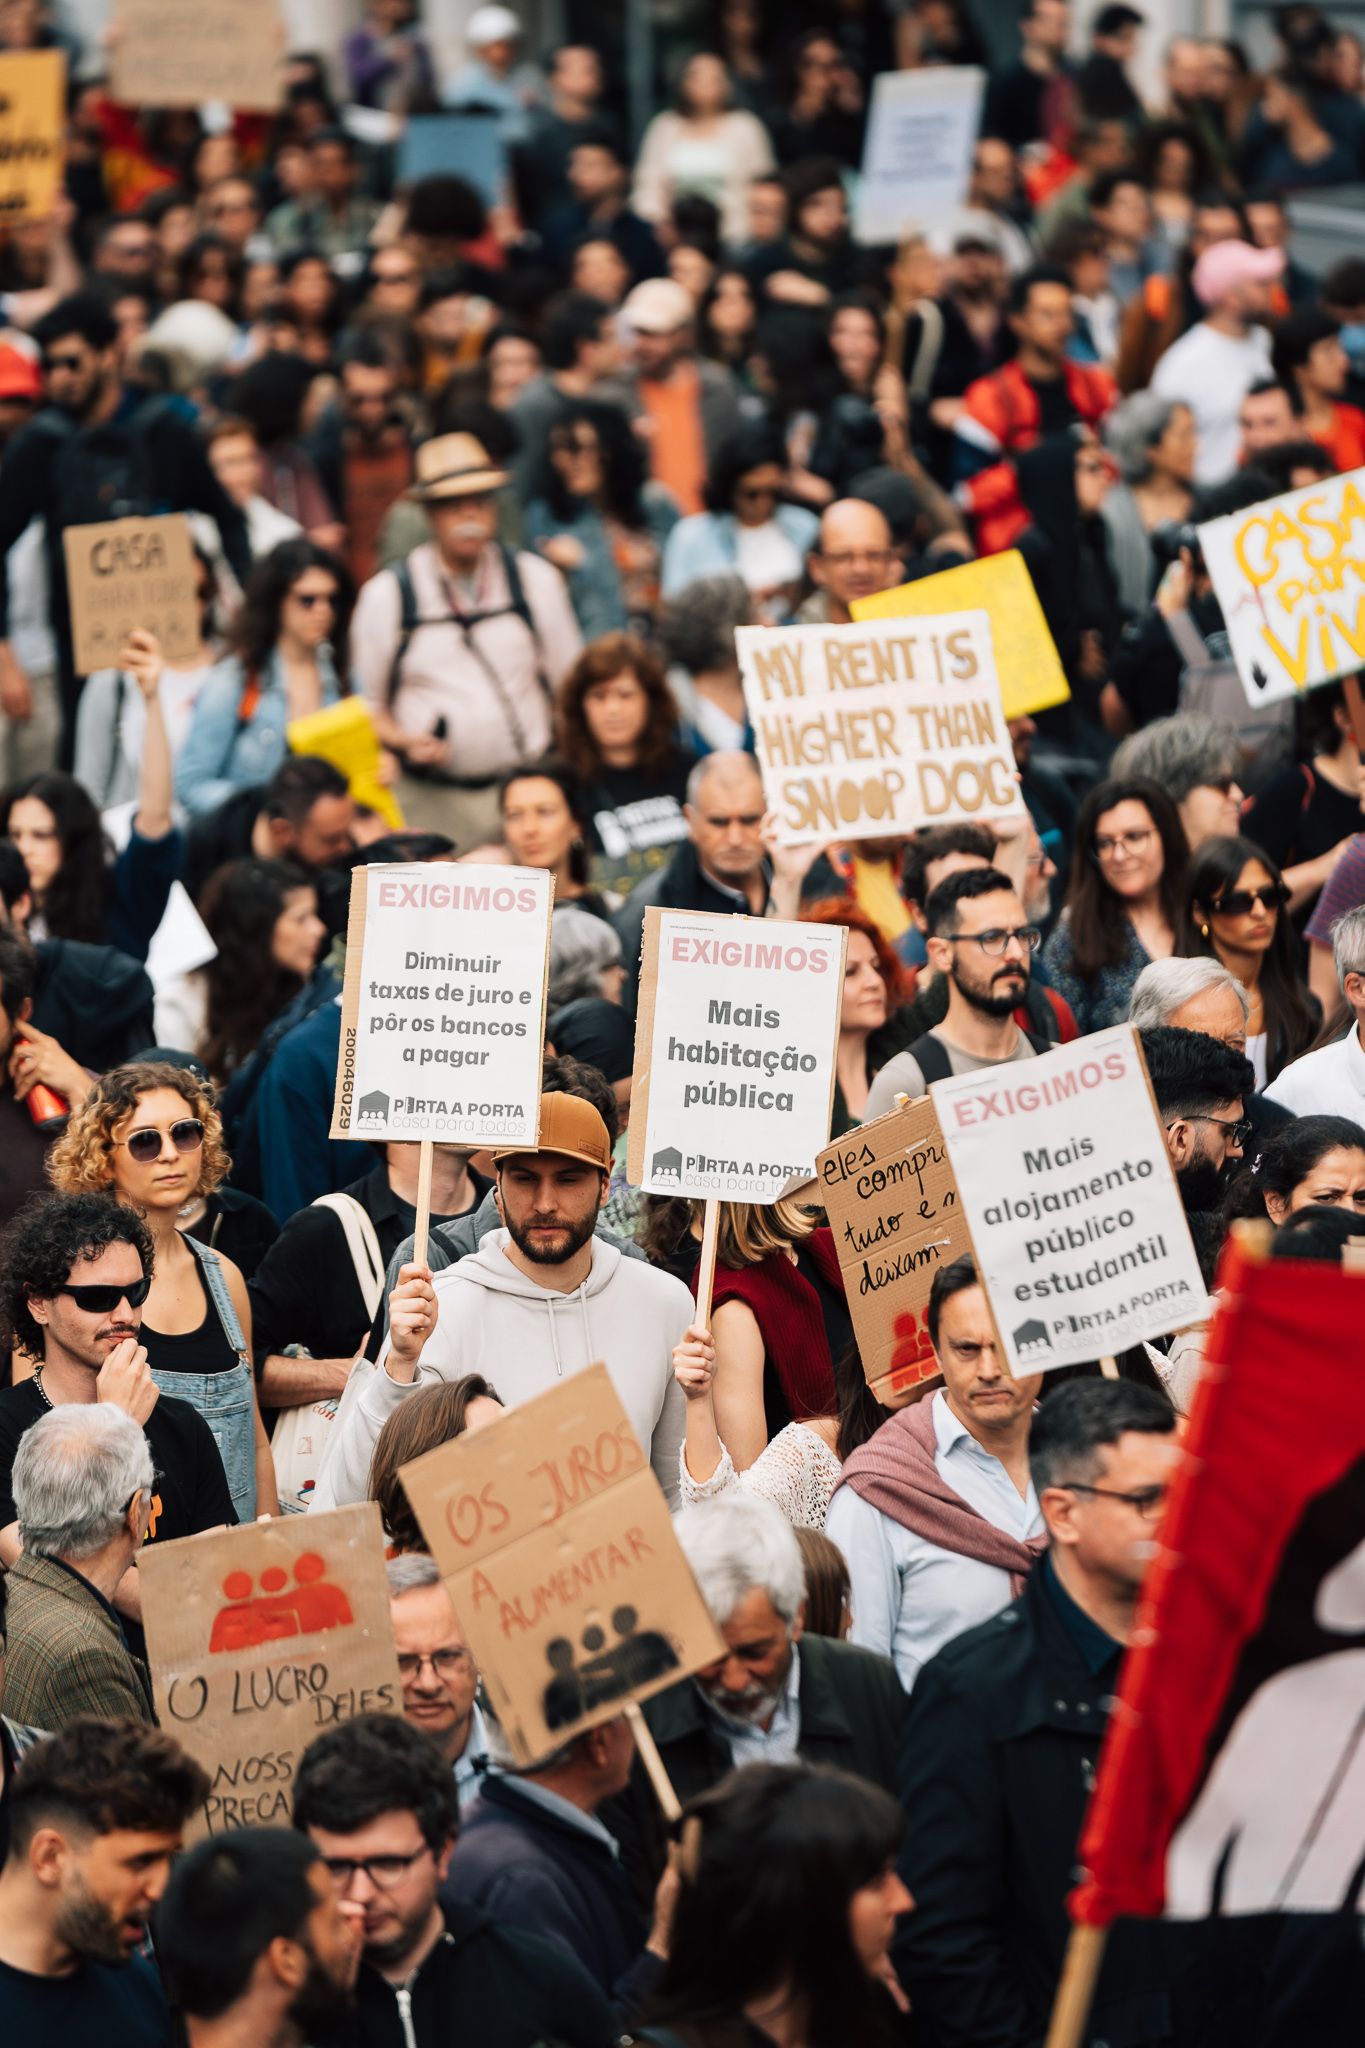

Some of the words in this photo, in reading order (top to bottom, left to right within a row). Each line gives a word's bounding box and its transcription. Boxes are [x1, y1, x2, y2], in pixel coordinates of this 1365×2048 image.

[90, 532, 168, 577] CASA
[1233, 480, 1365, 587] CASA
[753, 641, 805, 701] MY
[822, 635, 917, 691] RENT
[908, 700, 997, 751] THAN
[782, 767, 905, 831] SNOOP
[917, 757, 1015, 816] DOG
[378, 883, 537, 913] EXIGIMOS
[404, 951, 502, 974] Diminuir
[671, 937, 829, 974] EXIGIMOS
[369, 981, 430, 1001] taxas
[435, 983, 465, 1002] de
[467, 984, 514, 1007] juro
[519, 989, 532, 1005] e
[707, 999, 781, 1029] Mais
[369, 1012, 407, 1034] pôr
[411, 1015, 435, 1032] os
[440, 1014, 527, 1037] bancos
[402, 1047, 415, 1063] a
[419, 1048, 490, 1068] pagar
[667, 1036, 817, 1078] habitação
[339, 1028, 357, 1130] 200046029
[683, 1080, 794, 1112] pública
[952, 1053, 1127, 1127] EXIGIMOS
[392, 1115, 428, 1130] casa
[435, 1118, 474, 1134] para
[480, 1117, 527, 1134] todos
[393, 1096, 448, 1114] PRTA
[450, 1102, 463, 1115] A
[467, 1103, 525, 1118] PORTA
[685, 1154, 740, 1175] PRTA
[741, 1162, 755, 1176] A
[822, 1144, 876, 1186] eles
[1023, 1137, 1095, 1174] Mais
[684, 1174, 722, 1189] casa
[727, 1178, 765, 1194] para
[983, 1159, 1154, 1225] alojamento
[843, 1212, 904, 1253] tudo
[916, 1200, 937, 1219] e
[1024, 1209, 1135, 1264] público
[859, 1245, 941, 1297] deixam
[1014, 1234, 1168, 1302] estudantil
[1053, 1309, 1116, 1335] PRTA
[1118, 1303, 1128, 1317] A
[1130, 1280, 1191, 1312] PORTA
[445, 1480, 511, 1548] OS
[527, 1419, 643, 1528] JUROS
[470, 1567, 499, 1613] A
[499, 1526, 657, 1640] AUMENTAR
[167, 1676, 209, 1722] O
[232, 1662, 328, 1717] LUCRO
[212, 1751, 293, 1789] NOSS
